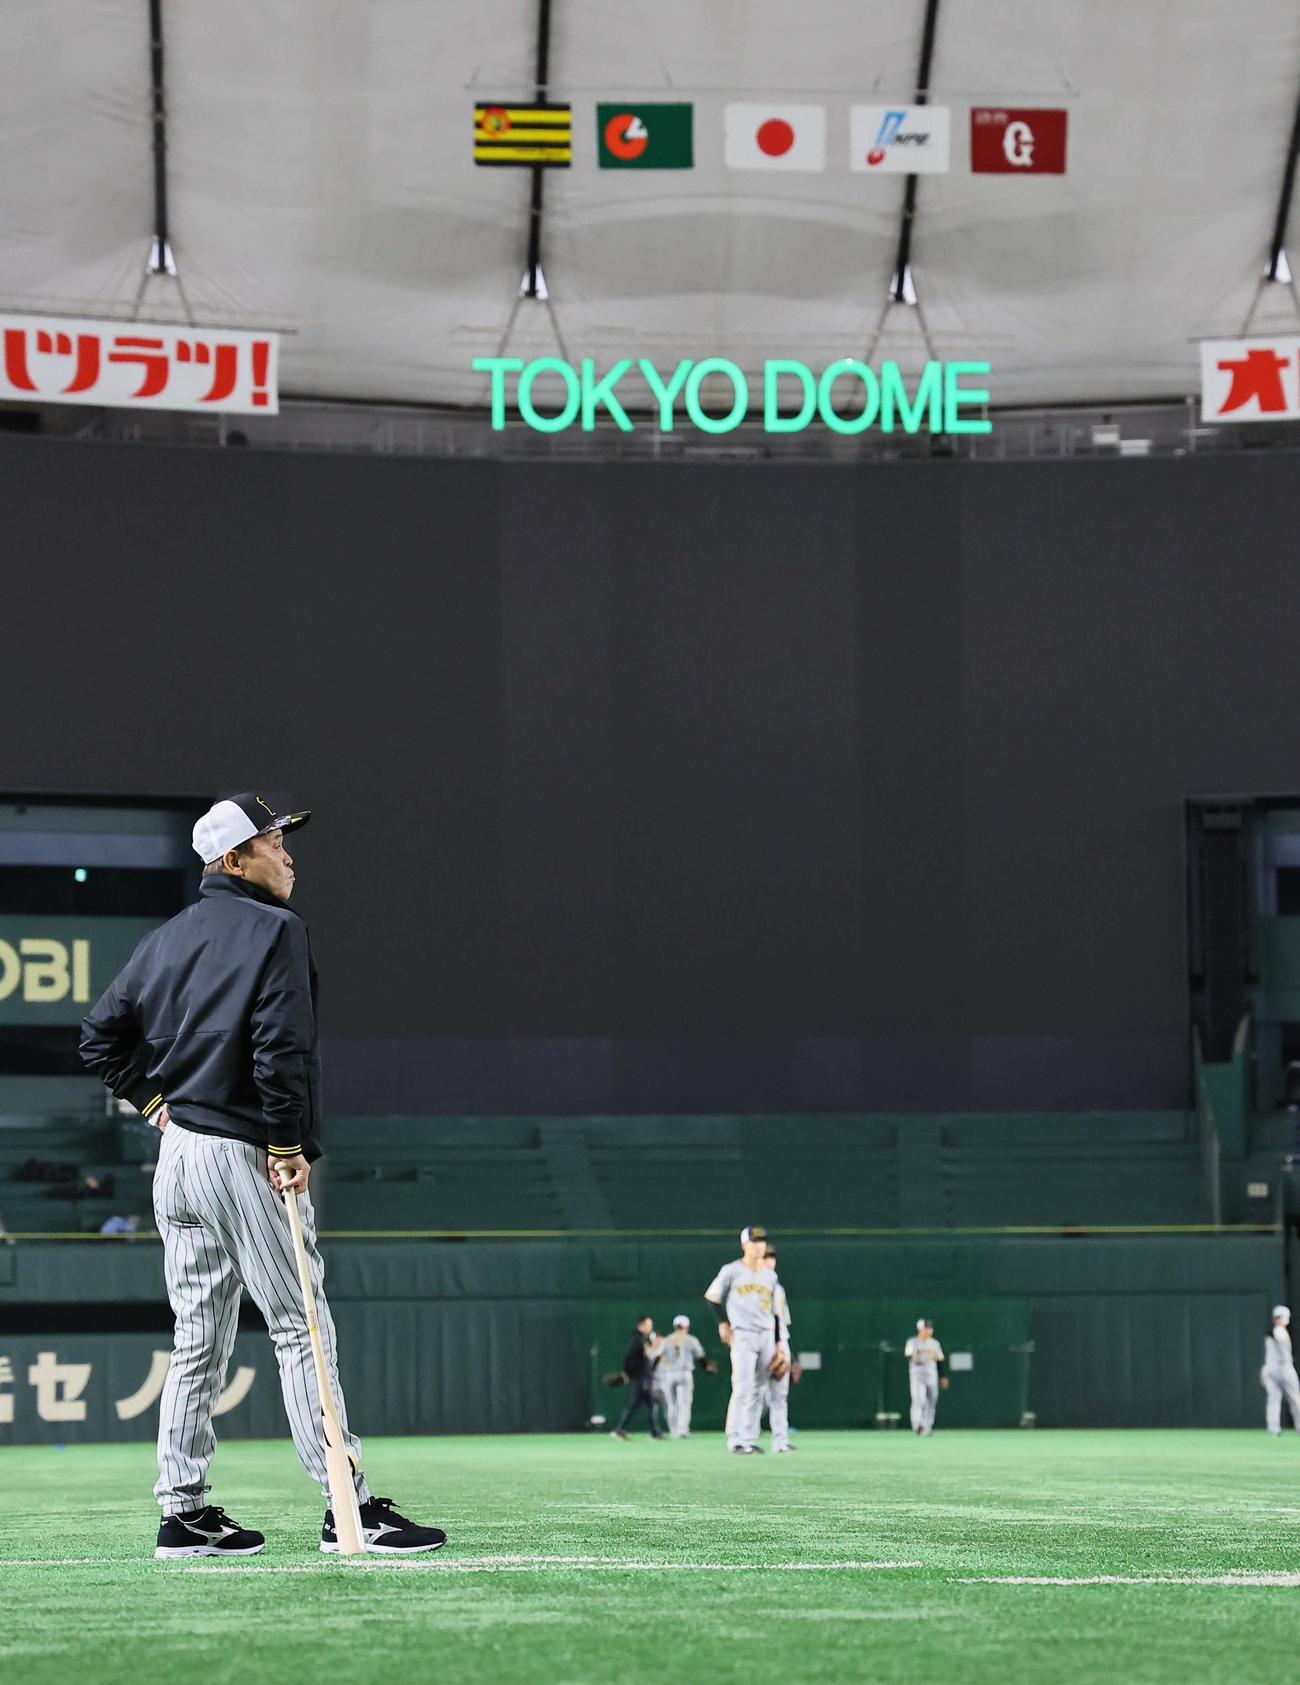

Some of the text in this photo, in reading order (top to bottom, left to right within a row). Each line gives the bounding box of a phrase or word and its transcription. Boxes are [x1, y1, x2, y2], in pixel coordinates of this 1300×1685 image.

[1003, 120, 1034, 166] G
[472, 357, 993, 434] TOKYO DOME
[1217, 348, 1300, 413] オ
